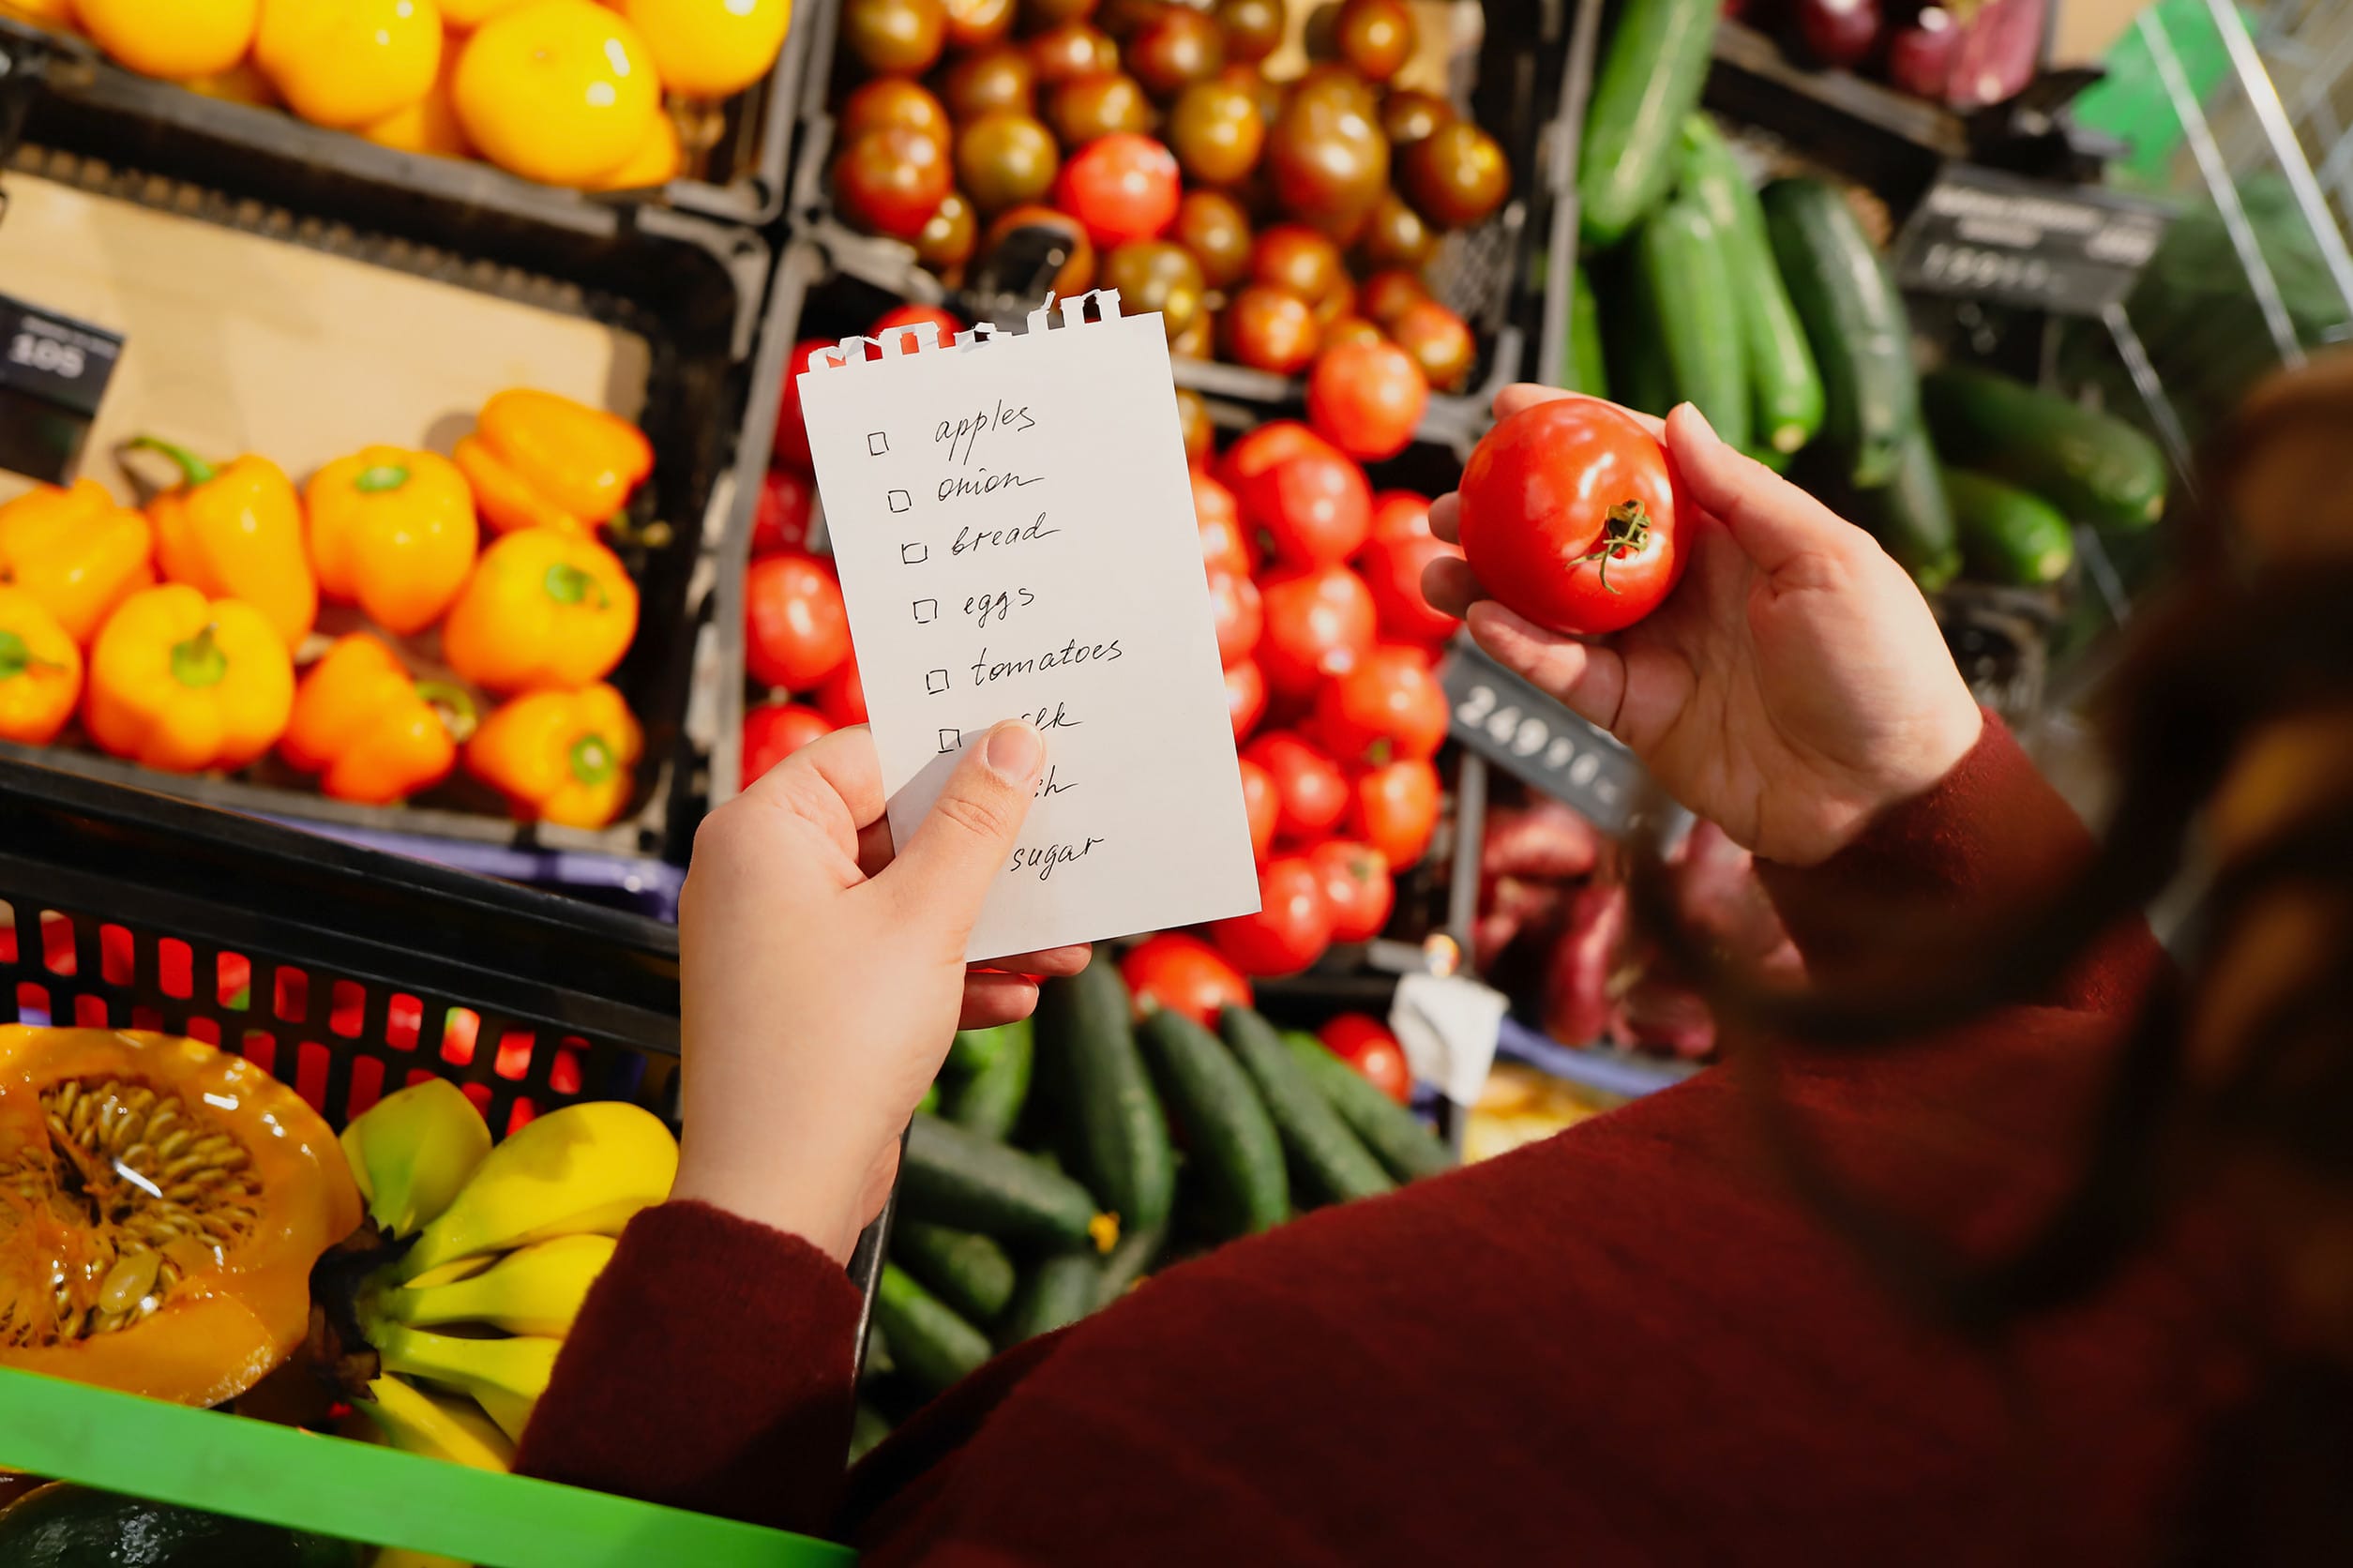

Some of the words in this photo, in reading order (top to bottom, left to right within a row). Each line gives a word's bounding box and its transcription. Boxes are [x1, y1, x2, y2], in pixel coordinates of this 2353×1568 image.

[934, 399, 1036, 466] apples
[937, 467, 1046, 502] onion
[950, 511, 1062, 556] bread
[962, 586, 1035, 629] eggs
[970, 638, 1124, 686] tomatoes
[1021, 701, 1083, 731] lk
[1009, 837, 1105, 882] sugar
